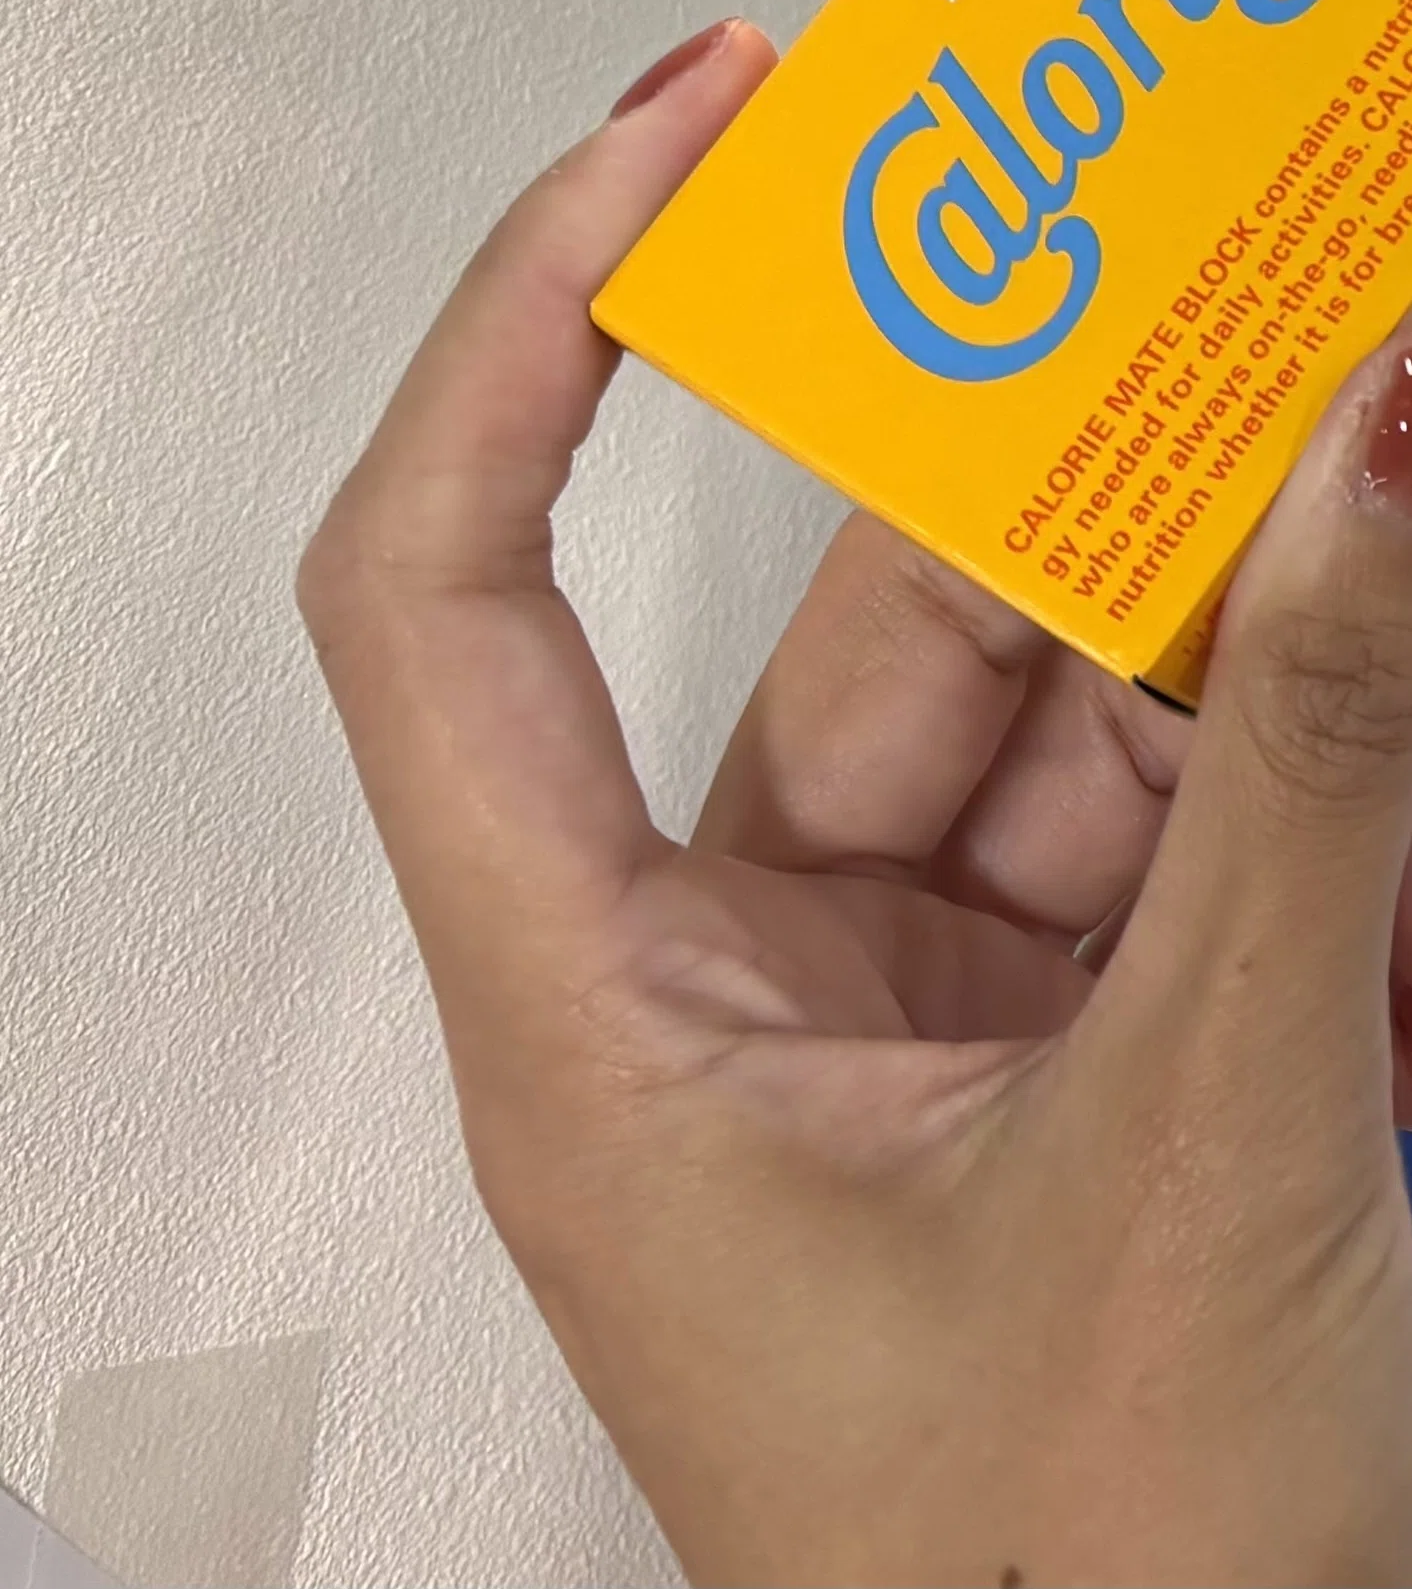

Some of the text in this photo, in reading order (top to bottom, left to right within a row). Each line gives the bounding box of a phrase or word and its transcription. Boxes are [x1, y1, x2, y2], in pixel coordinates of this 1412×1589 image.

[1004, 413, 1116, 554] CALORIE
[1103, 320, 1185, 419] MATE
[1169, 215, 1263, 326] BLOCK
[1255, 96, 1352, 220] contains
[1346, 72, 1371, 96] a
[1041, 533, 1082, 582] gy
[1074, 411, 1167, 534] needed
[1155, 361, 1203, 414] for
[1199, 282, 1265, 362] daily
[1257, 141, 1372, 281] activities.
[1071, 527, 1133, 602] who
[1127, 472, 1174, 527] are
[1167, 362, 1254, 473] always
[1247, 214, 1369, 362] on-the-go,
[1105, 486, 1215, 624] nutrition
[1204, 353, 1308, 484] whether
[1293, 324, 1331, 355] it
[1314, 295, 1353, 326] is
[1338, 245, 1386, 293] for
